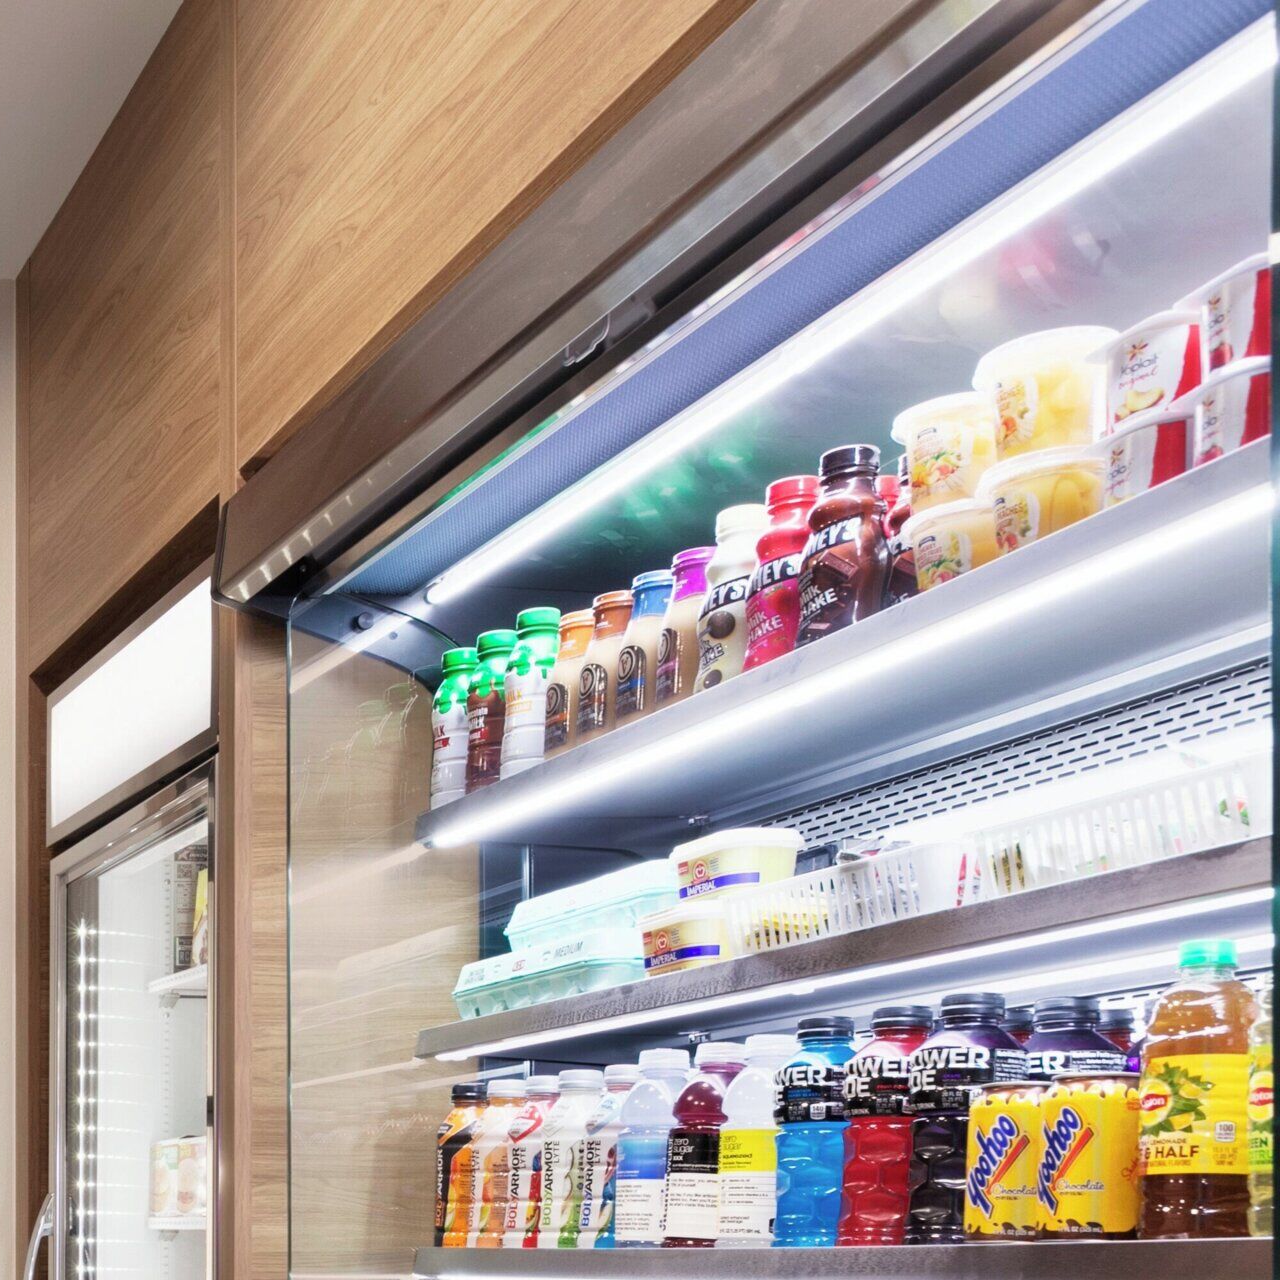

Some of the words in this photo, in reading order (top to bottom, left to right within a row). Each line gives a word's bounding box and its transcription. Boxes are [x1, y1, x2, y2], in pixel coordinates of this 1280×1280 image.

[673, 1145, 694, 1156] sugar
[1155, 1145, 1200, 1159] HALF
[507, 1147, 521, 1229] BODYARMOR
[542, 1141, 553, 1226] BODYARMOR
[581, 1140, 595, 1227] BODYARMOR
[1056, 1178, 1106, 1192] Chocolate
